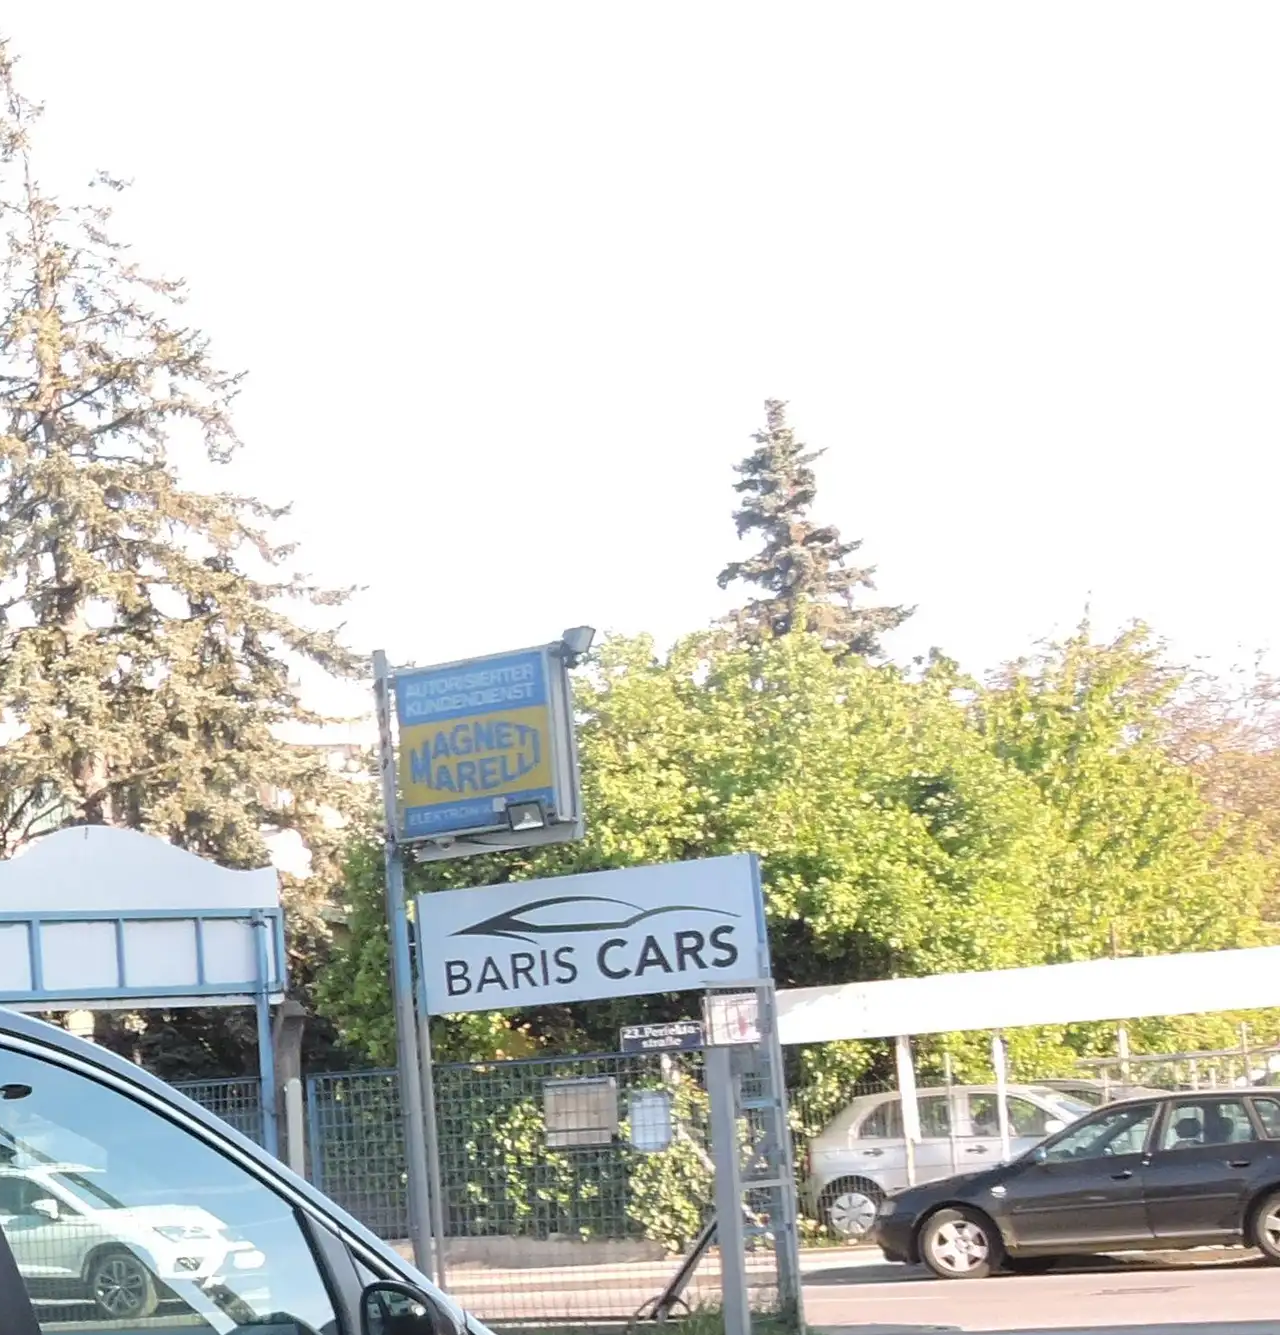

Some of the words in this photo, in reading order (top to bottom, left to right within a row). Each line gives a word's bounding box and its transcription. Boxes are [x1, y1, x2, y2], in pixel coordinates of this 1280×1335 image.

[406, 663, 534, 698] AUTORISIERTER
[406, 682, 535, 718] KUNDENDIENST
[444, 946, 578, 996] BARIS
[597, 925, 739, 980] CARS
